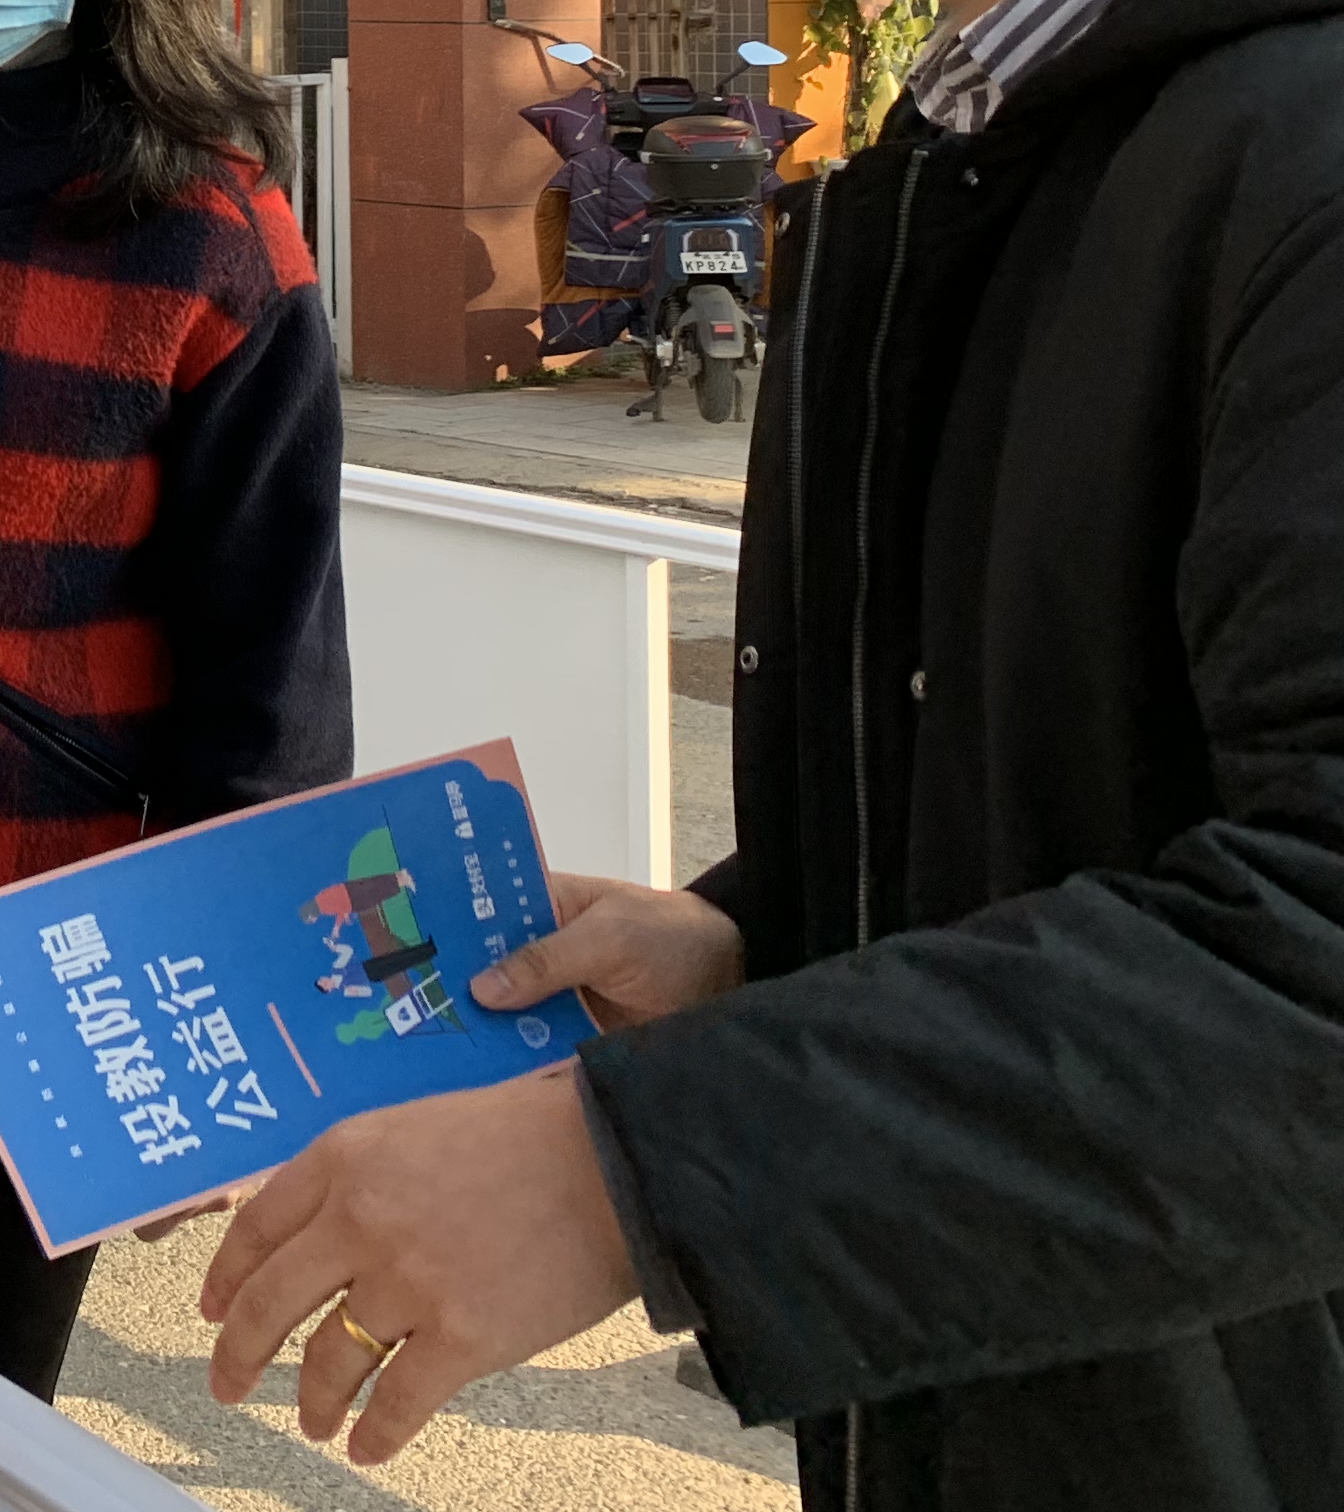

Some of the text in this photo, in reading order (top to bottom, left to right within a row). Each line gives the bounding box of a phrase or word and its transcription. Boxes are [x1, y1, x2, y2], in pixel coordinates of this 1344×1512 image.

[39, 912, 202, 1166] 投教防骗
[143, 954, 280, 1131] 公益行
